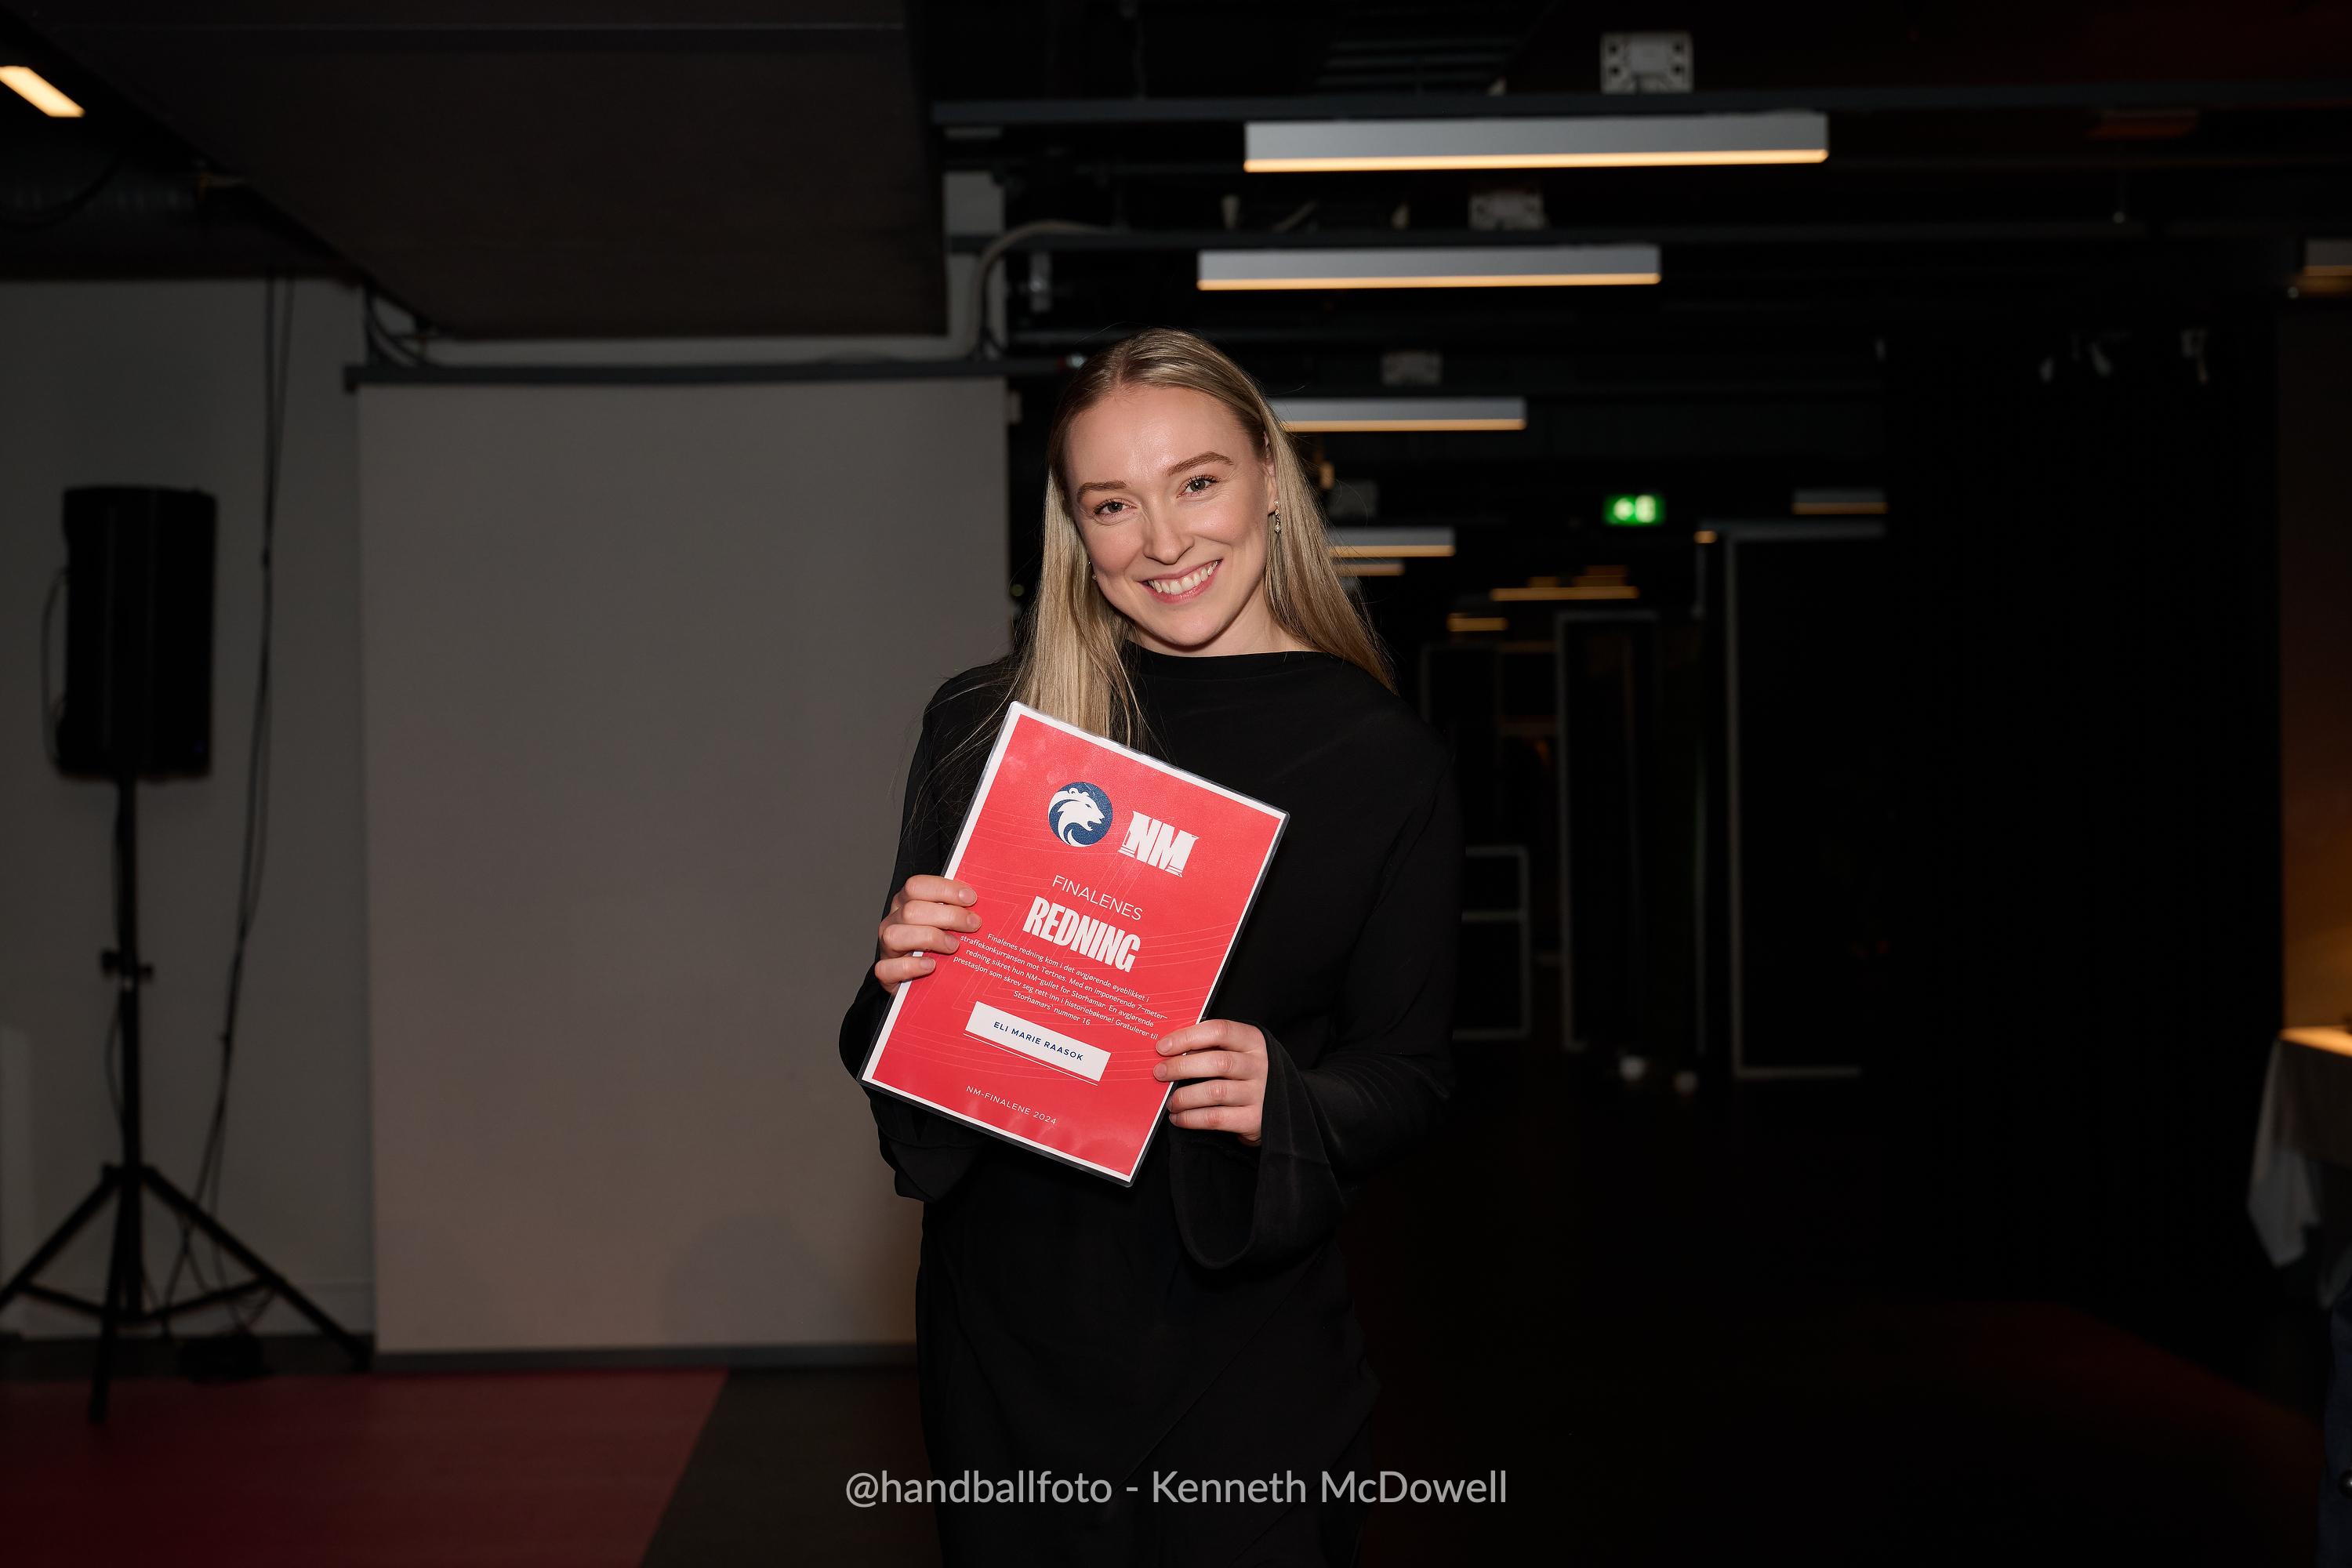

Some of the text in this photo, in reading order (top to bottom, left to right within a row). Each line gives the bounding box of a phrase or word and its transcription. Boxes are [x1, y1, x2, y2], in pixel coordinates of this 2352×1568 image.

[1117, 810, 1200, 878] NM
[1051, 874, 1143, 920] FINALENES
[987, 933, 1018, 951] Finalenes
[1018, 947, 1044, 963] redning
[1044, 956, 1059, 967] kom
[1063, 964, 1076, 974] det
[1076, 970, 1112, 988] avgjørende
[1112, 985, 1145, 1001] øyeblikket
[1022, 895, 1141, 973] REDNING
[953, 956, 988, 974] prestasjon
[989, 970, 1003, 979] som
[1003, 975, 1022, 986] skrev
[1022, 983, 1034, 993] seg
[1034, 989, 1048, 998] rett
[1048, 993, 1060, 1002] inn
[1064, 998, 1115, 1023] historiebøkene!
[1115, 1019, 1150, 1036] Gratulerer
[960, 935, 1025, 965] straffekonkurransen
[1026, 962, 1040, 971] mot
[1041, 966, 1067, 982] Tertnes.
[1069, 978, 1084, 989] Med
[1094, 987, 1136, 1009] imponerende
[965, 949, 1154, 1028] redning sikret hun NM-gullet for Storhamar. En avgjørende
[993, 1021, 1083, 1061] ELI MARIE RAASOK
[1054, 1007, 1081, 1022] nummer
[966, 1085, 1057, 1125] NM-FINALENE 2024
